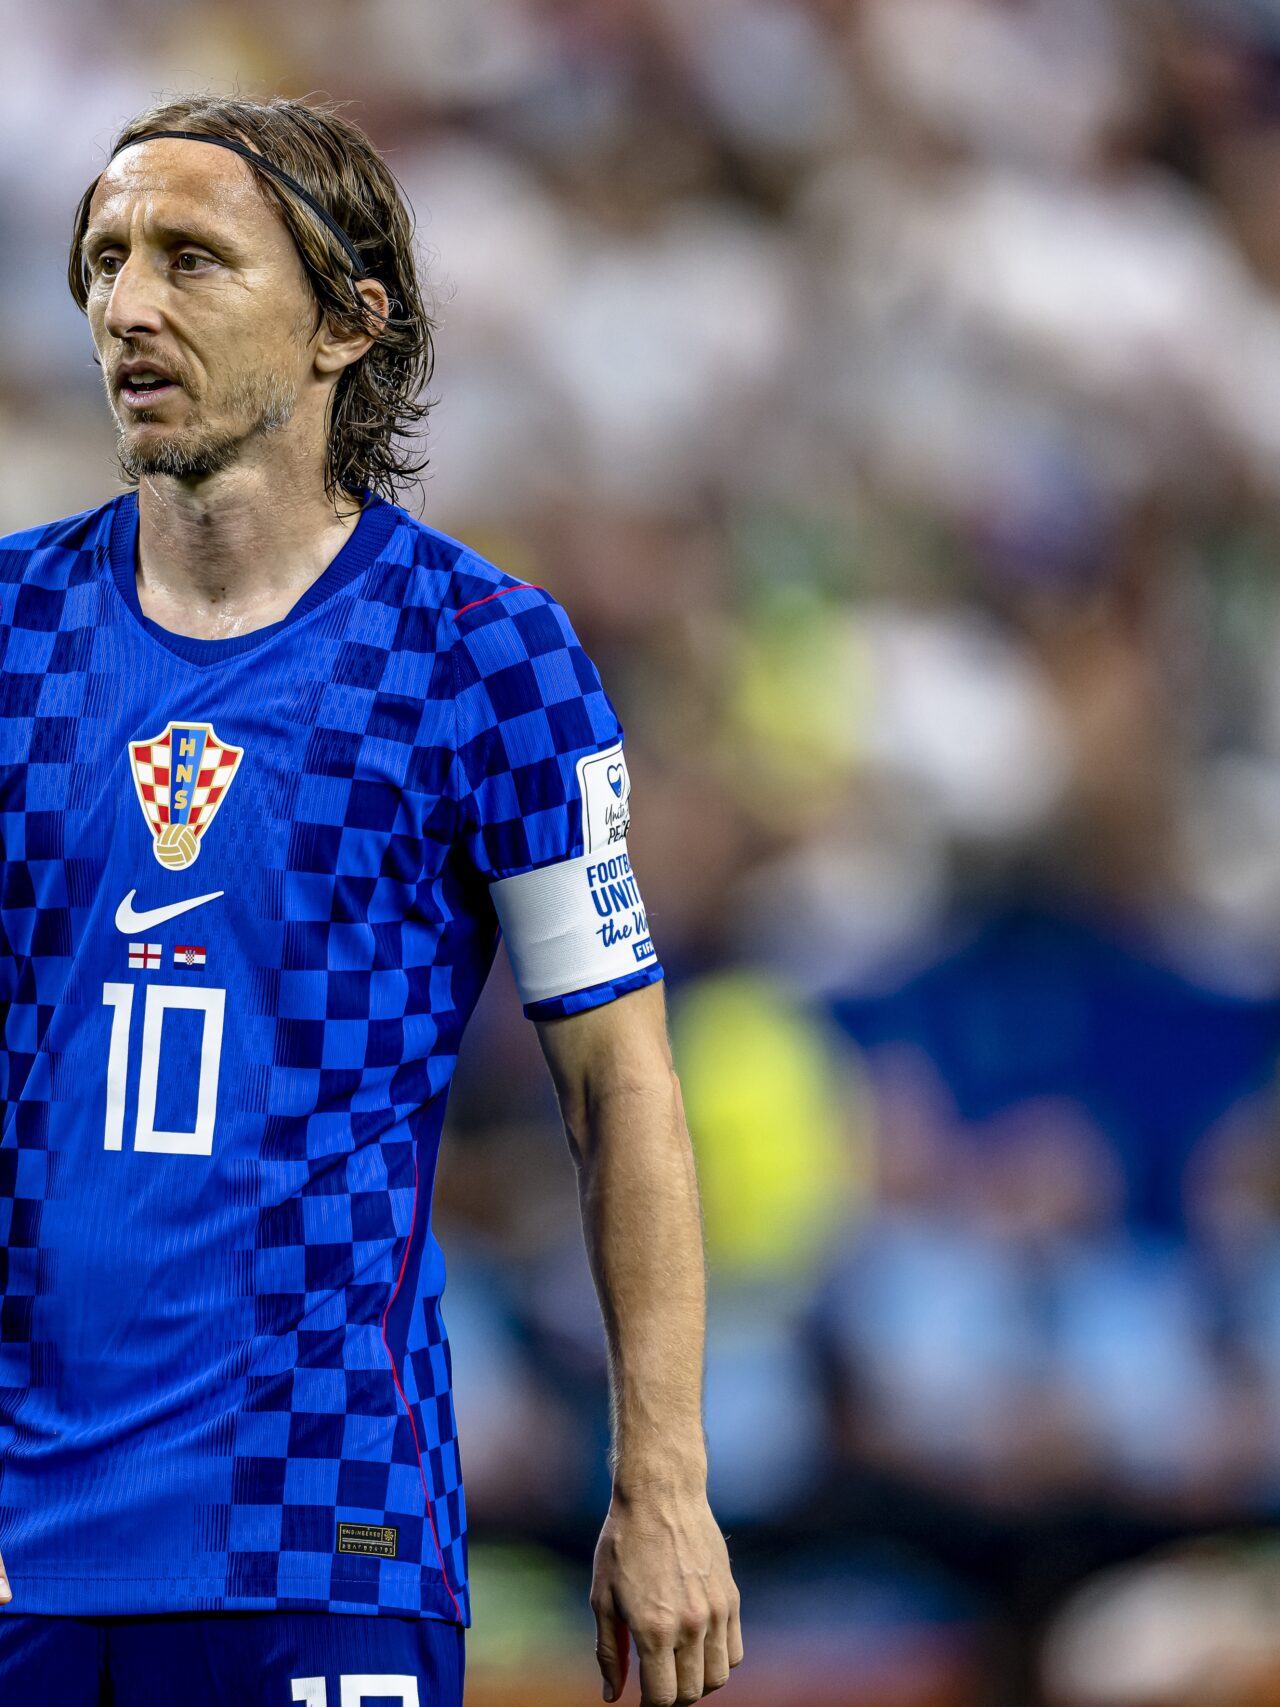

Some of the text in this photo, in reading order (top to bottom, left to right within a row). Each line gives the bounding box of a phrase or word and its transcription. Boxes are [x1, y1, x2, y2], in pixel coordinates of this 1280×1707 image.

[174, 738, 196, 810] HNS
[591, 876, 639, 917] UNIT
[596, 908, 648, 947] the W
[636, 942, 654, 957] FIF
[103, 982, 226, 1156] 10
